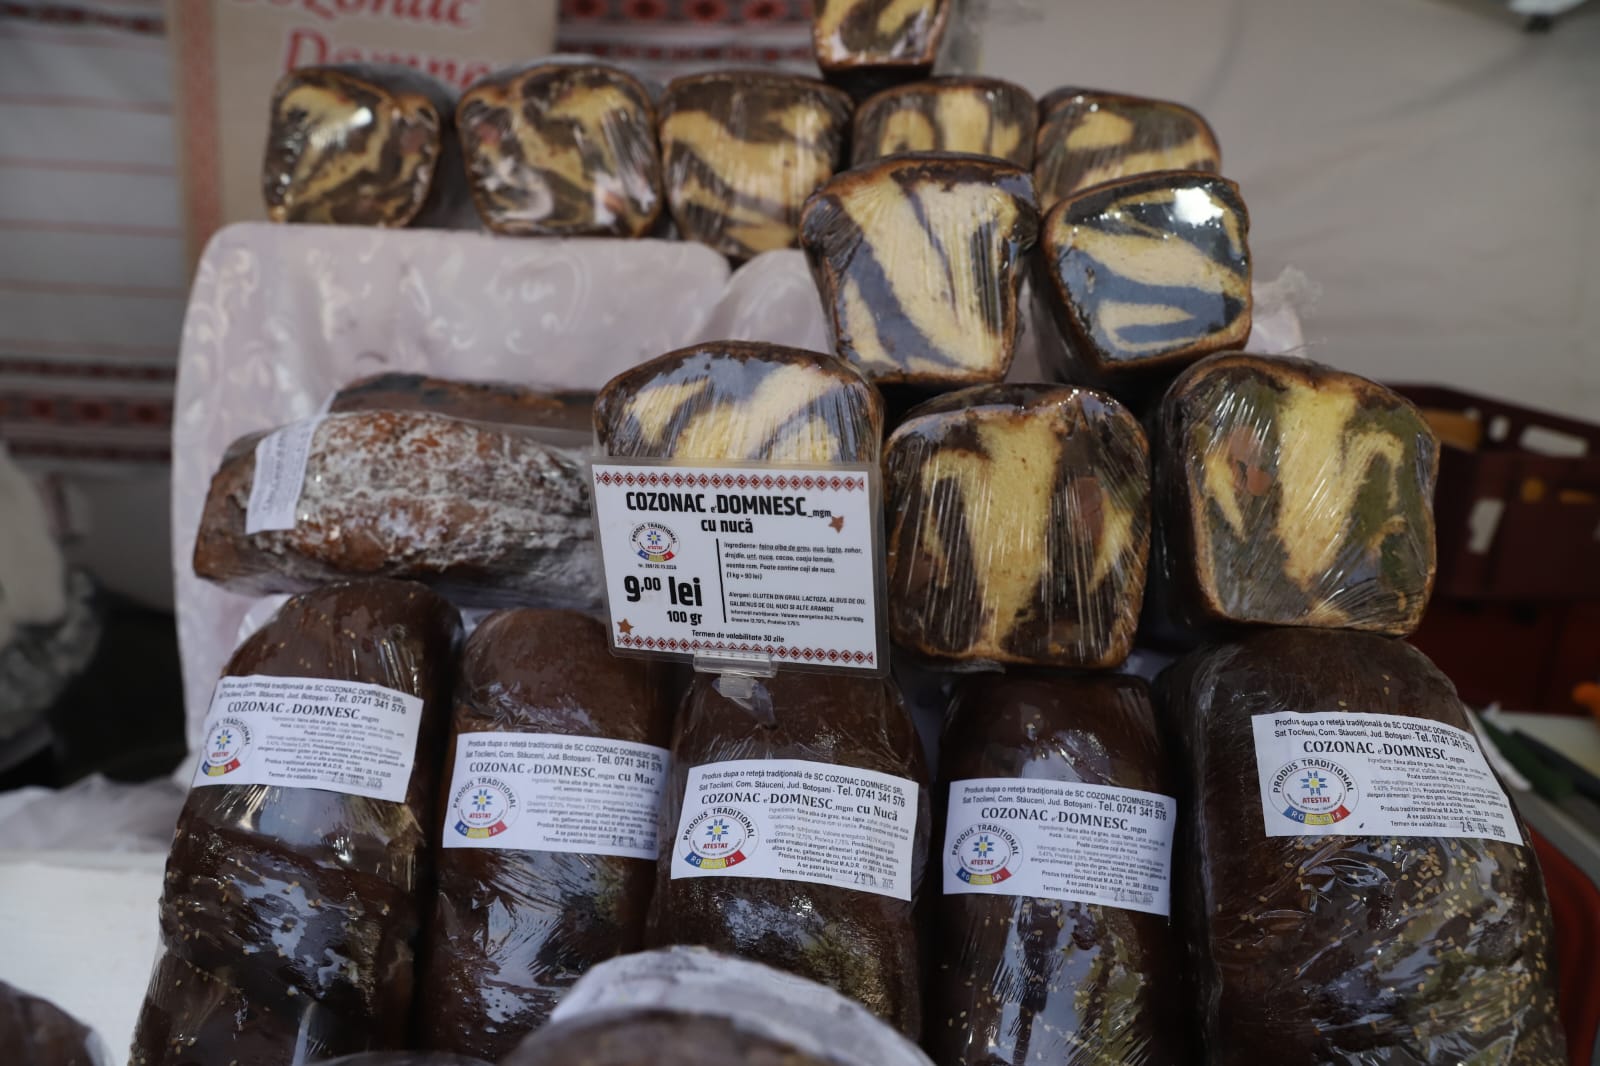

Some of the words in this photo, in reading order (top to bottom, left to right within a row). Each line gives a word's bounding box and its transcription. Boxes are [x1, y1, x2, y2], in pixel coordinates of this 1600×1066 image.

[626, 492, 706, 513] COZONAC
[701, 520, 717, 532] cu
[720, 518, 754, 533] nucă
[668, 576, 703, 607] lei
[667, 610, 687, 623] 100
[690, 613, 703, 626] gr
[692, 629, 715, 638] Termen
[716, 631, 725, 639] de
[726, 632, 762, 641] valabilitate
[763, 634, 772, 642] 30
[773, 635, 785, 643] zile
[324, 685, 358, 694] COZONAC
[227, 701, 285, 713] COZONAC
[334, 693, 349, 703] Tel.
[351, 695, 372, 705] 0741
[373, 700, 389, 710] 341
[391, 703, 407, 715] 576
[1275, 718, 1300, 727] Produs
[1402, 722, 1432, 733] COZONAC
[1303, 740, 1375, 754] COZONAC
[1319, 728, 1337, 736] Com.
[1415, 731, 1432, 742] Tel.
[1432, 735, 1450, 746] 0741
[585, 744, 618, 754] COZONAC
[620, 748, 650, 759] DOMNESC
[597, 753, 612, 764] Tel.
[614, 756, 634, 767] 0741
[636, 759, 649, 769] 341
[469, 762, 525, 774] COZONAC
[618, 773, 631, 782] cu
[634, 772, 656, 786] Mac
[702, 772, 722, 780] Produs
[723, 770, 739, 779] dupa
[814, 773, 824, 781] SC
[824, 774, 860, 786] COZONAC
[860, 779, 892, 792] DOMNESC
[893, 786, 904, 796] SRL
[1273, 762, 1298, 793] PRODUS
[453, 780, 474, 809] PRODUS
[837, 785, 853, 797] Tel.
[855, 788, 875, 799] 0741
[878, 792, 891, 803] 341
[892, 795, 905, 807] 576
[985, 786, 1000, 794] dupa
[1075, 790, 1085, 798] SC
[1086, 791, 1120, 802] COZONAC
[1121, 795, 1154, 807] DOMNESC
[701, 792, 760, 804] COZONAC
[857, 805, 870, 814] cu
[873, 805, 898, 821] Nucă
[981, 807, 1048, 821] COZONAC
[1098, 801, 1114, 812] Tel.
[1116, 803, 1136, 814] 0741
[1139, 806, 1153, 817] 341
[1154, 810, 1167, 821] 576
[683, 811, 708, 841] PRODUS
[952, 827, 974, 856] PRODUS
